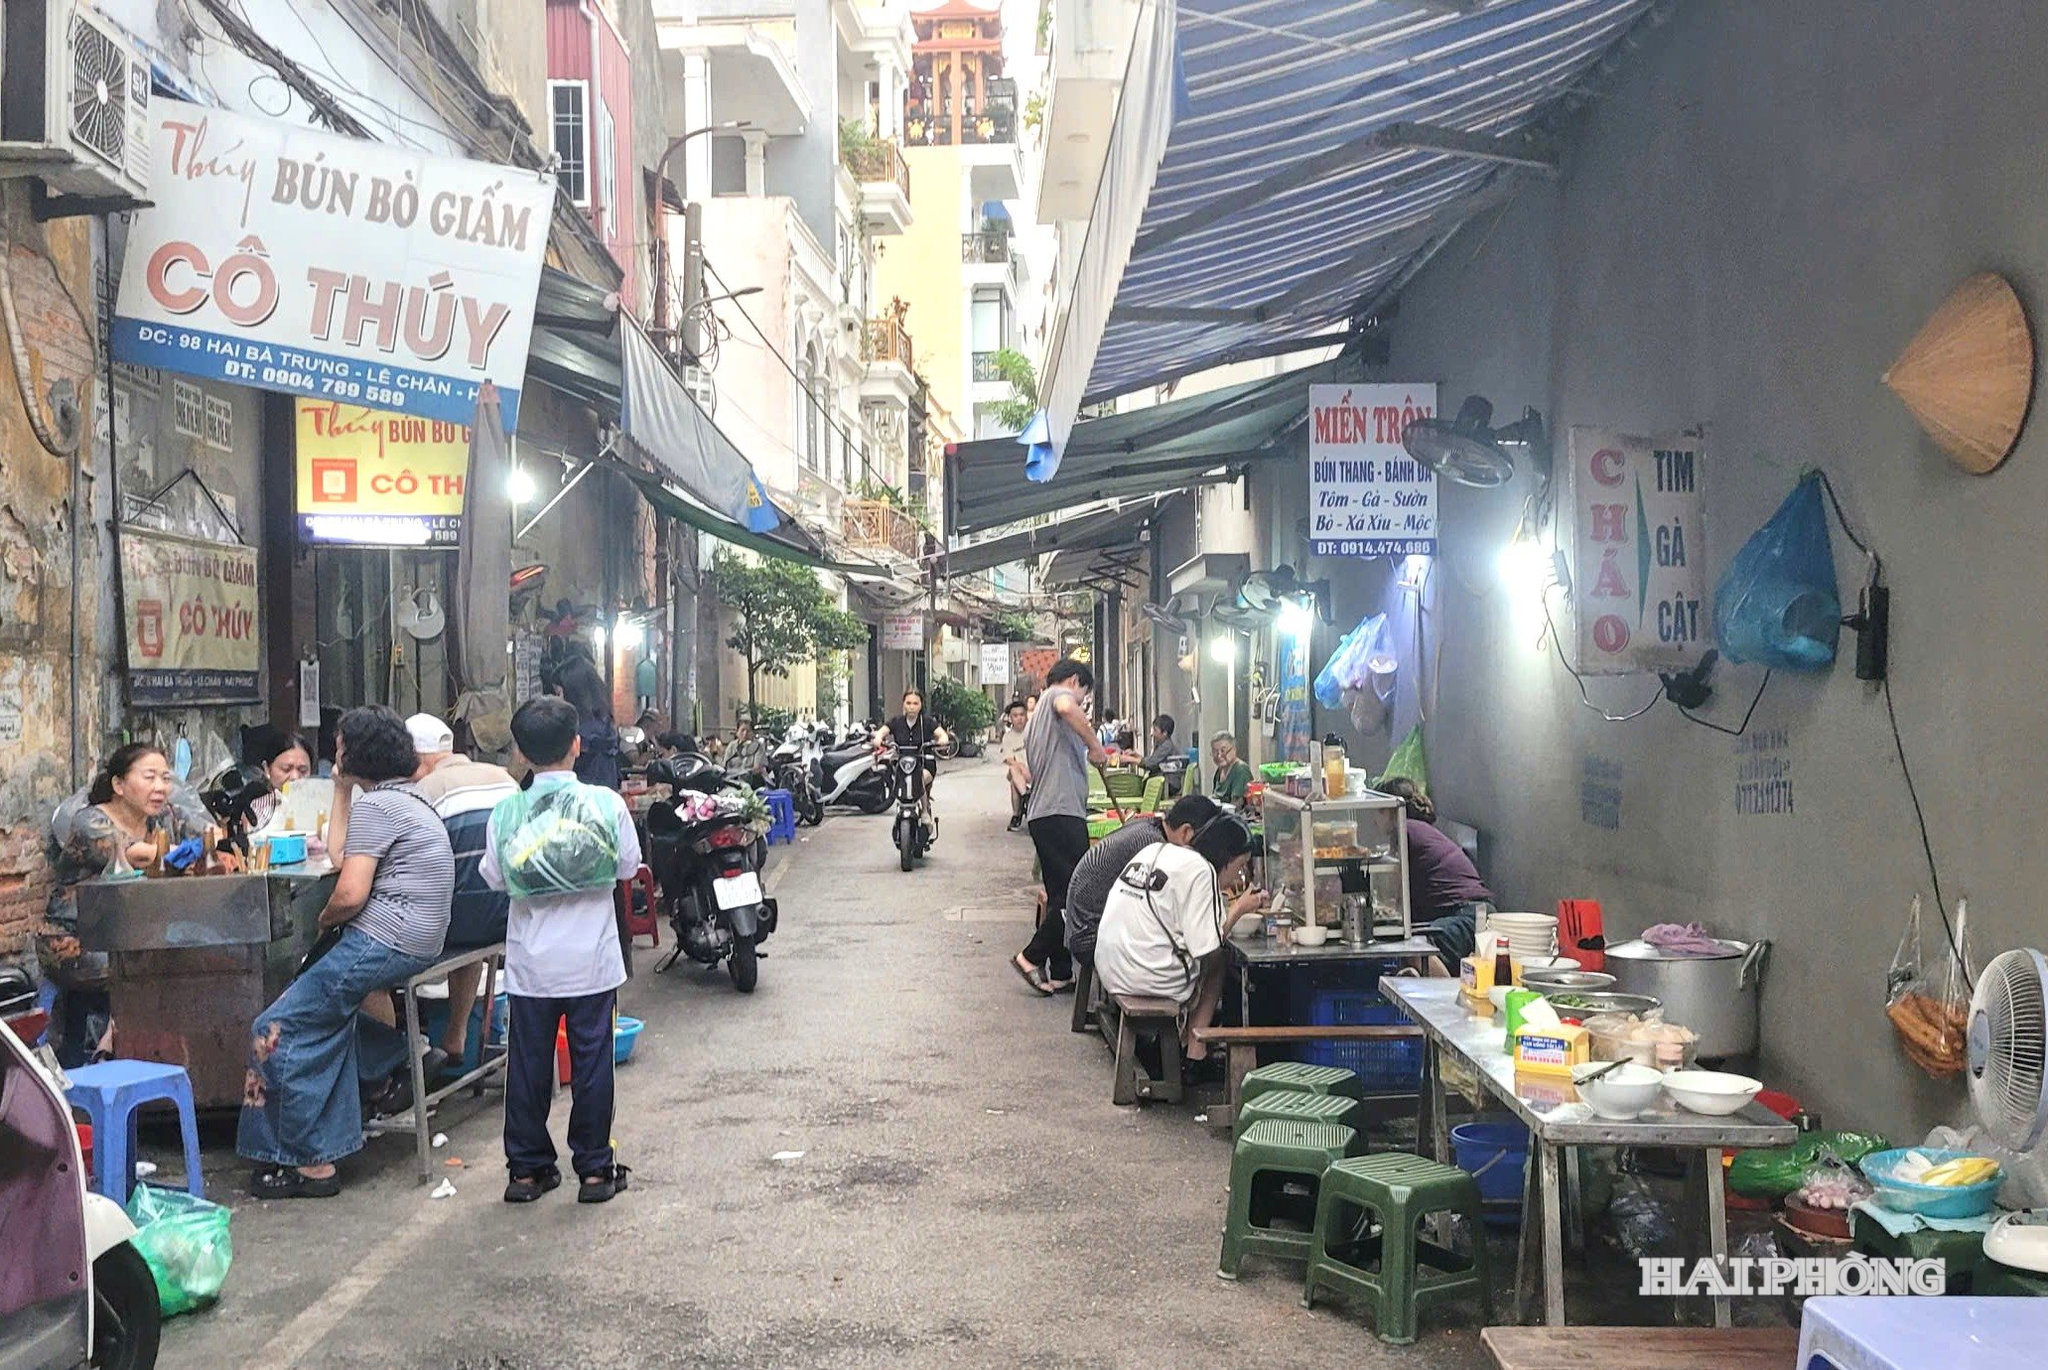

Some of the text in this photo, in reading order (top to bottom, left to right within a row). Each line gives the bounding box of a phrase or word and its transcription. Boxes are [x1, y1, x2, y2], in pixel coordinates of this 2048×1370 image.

[161, 115, 532, 252] Thúy BÚN BÒ GIẤM
[146, 234, 280, 328] CÔ
[306, 266, 511, 371] THÚY
[179, 333, 201, 350] 98
[206, 338, 240, 358] HAI
[245, 345, 273, 364] BÀ
[280, 351, 349, 378] TRƯNG
[367, 367, 392, 385] LÊ
[395, 373, 451, 397] CHÂN
[262, 366, 315, 392] 0904
[321, 377, 361, 398] 789
[365, 385, 405, 407] 589
[301, 401, 385, 459] Thúy
[388, 416, 426, 443] BÚN
[371, 468, 419, 495] CÔ
[1314, 456, 1336, 483] BÚN
[1339, 461, 1375, 483] THANG
[1385, 456, 1414, 483] BÁNH
[1653, 450, 1694, 492] TIM
[1319, 490, 1349, 508] Tôm
[1362, 490, 1381, 508] Gà
[1393, 489, 1428, 508] Sườn
[1316, 514, 1334, 531] Bò
[1346, 514, 1365, 531] Xá
[1404, 514, 1432, 535] Mộc
[1655, 516, 1686, 567] GÀ
[180, 593, 206, 636] CÔ
[1657, 591, 1699, 651] CẬT
